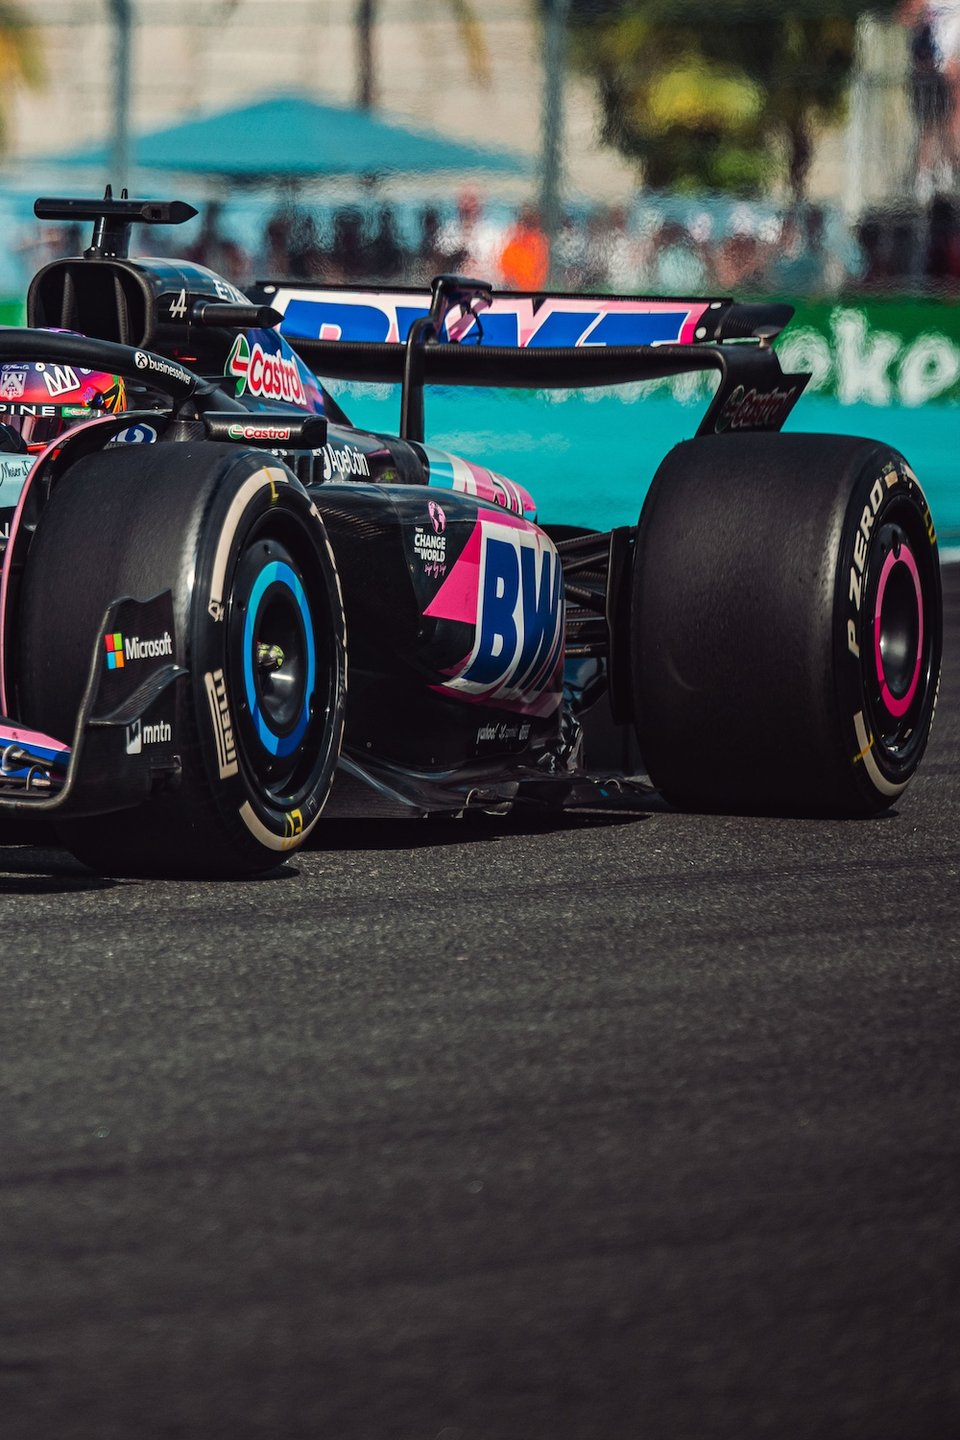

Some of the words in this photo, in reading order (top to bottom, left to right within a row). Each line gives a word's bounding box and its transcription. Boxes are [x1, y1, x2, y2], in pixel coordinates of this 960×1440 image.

[147, 354, 192, 385] businessolver
[248, 343, 307, 405] Castrol
[244, 427, 291, 441] Castrol
[326, 443, 370, 480] ApeCoin
[414, 533, 446, 550] CHANGE
[420, 549, 446, 562] WORLD
[849, 479, 883, 611] ZERO
[124, 631, 173, 661] Microsoft
[143, 720, 172, 744] mntn
[204, 668, 239, 781] PIRELLI
